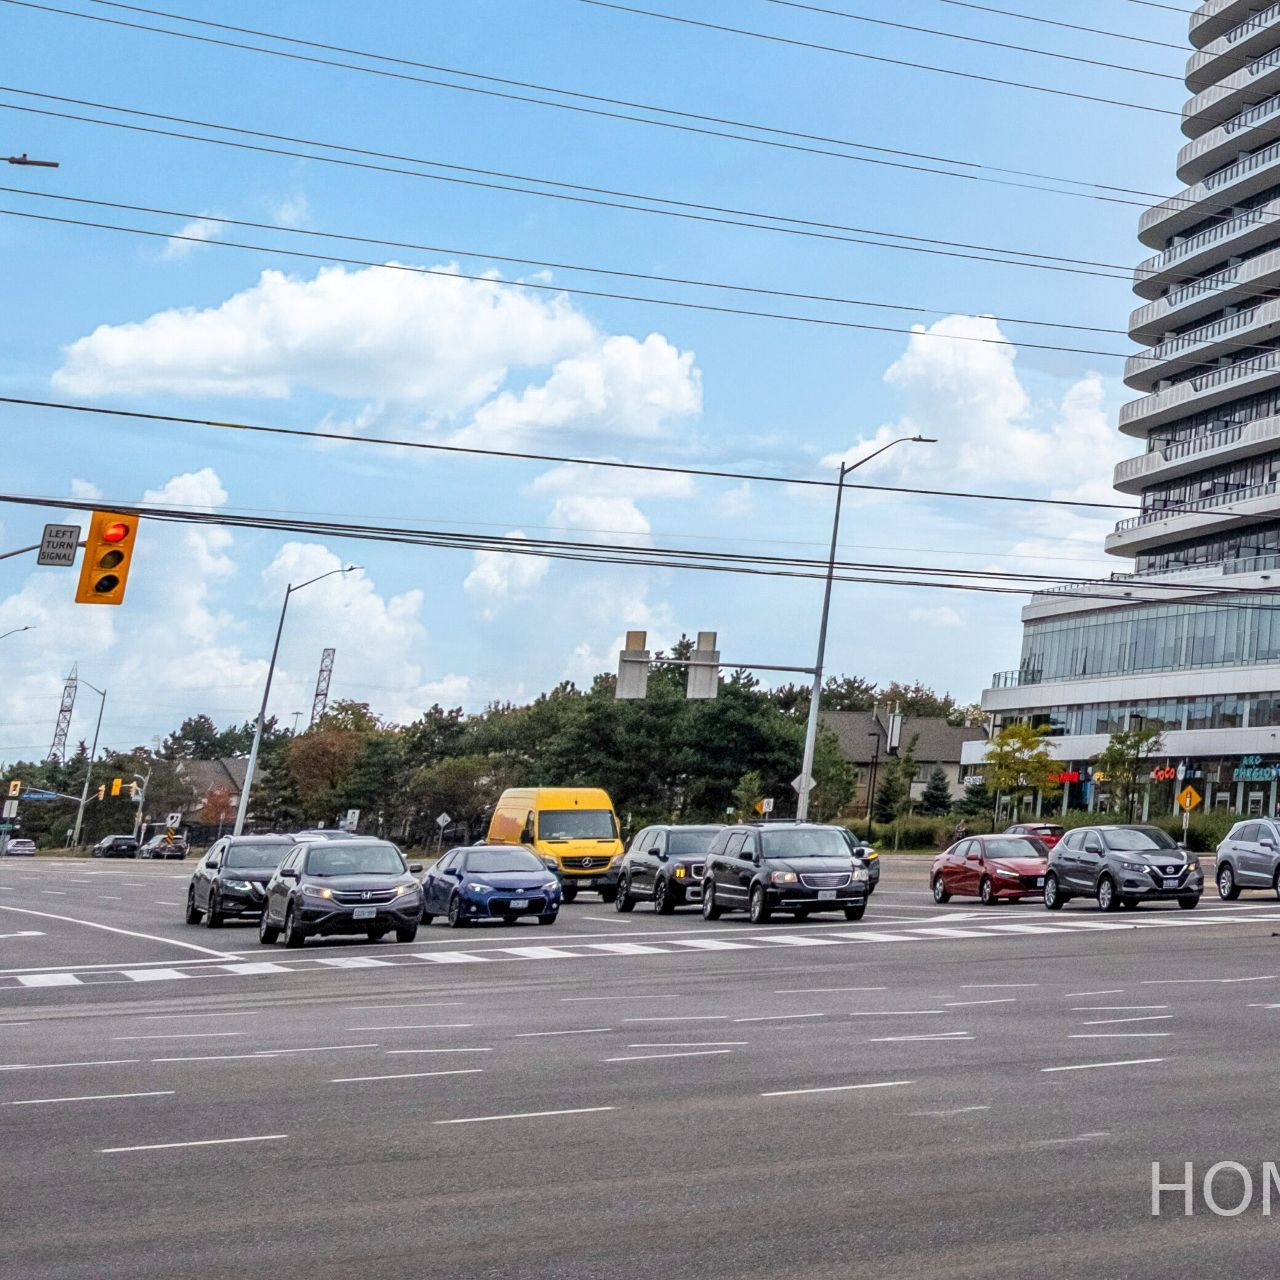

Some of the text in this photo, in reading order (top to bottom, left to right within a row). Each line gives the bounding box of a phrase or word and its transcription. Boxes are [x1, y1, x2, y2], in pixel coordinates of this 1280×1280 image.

[49, 529, 74, 539] LEFT
[46, 541, 74, 550] TURN
[40, 551, 72, 561] SIGNAL
